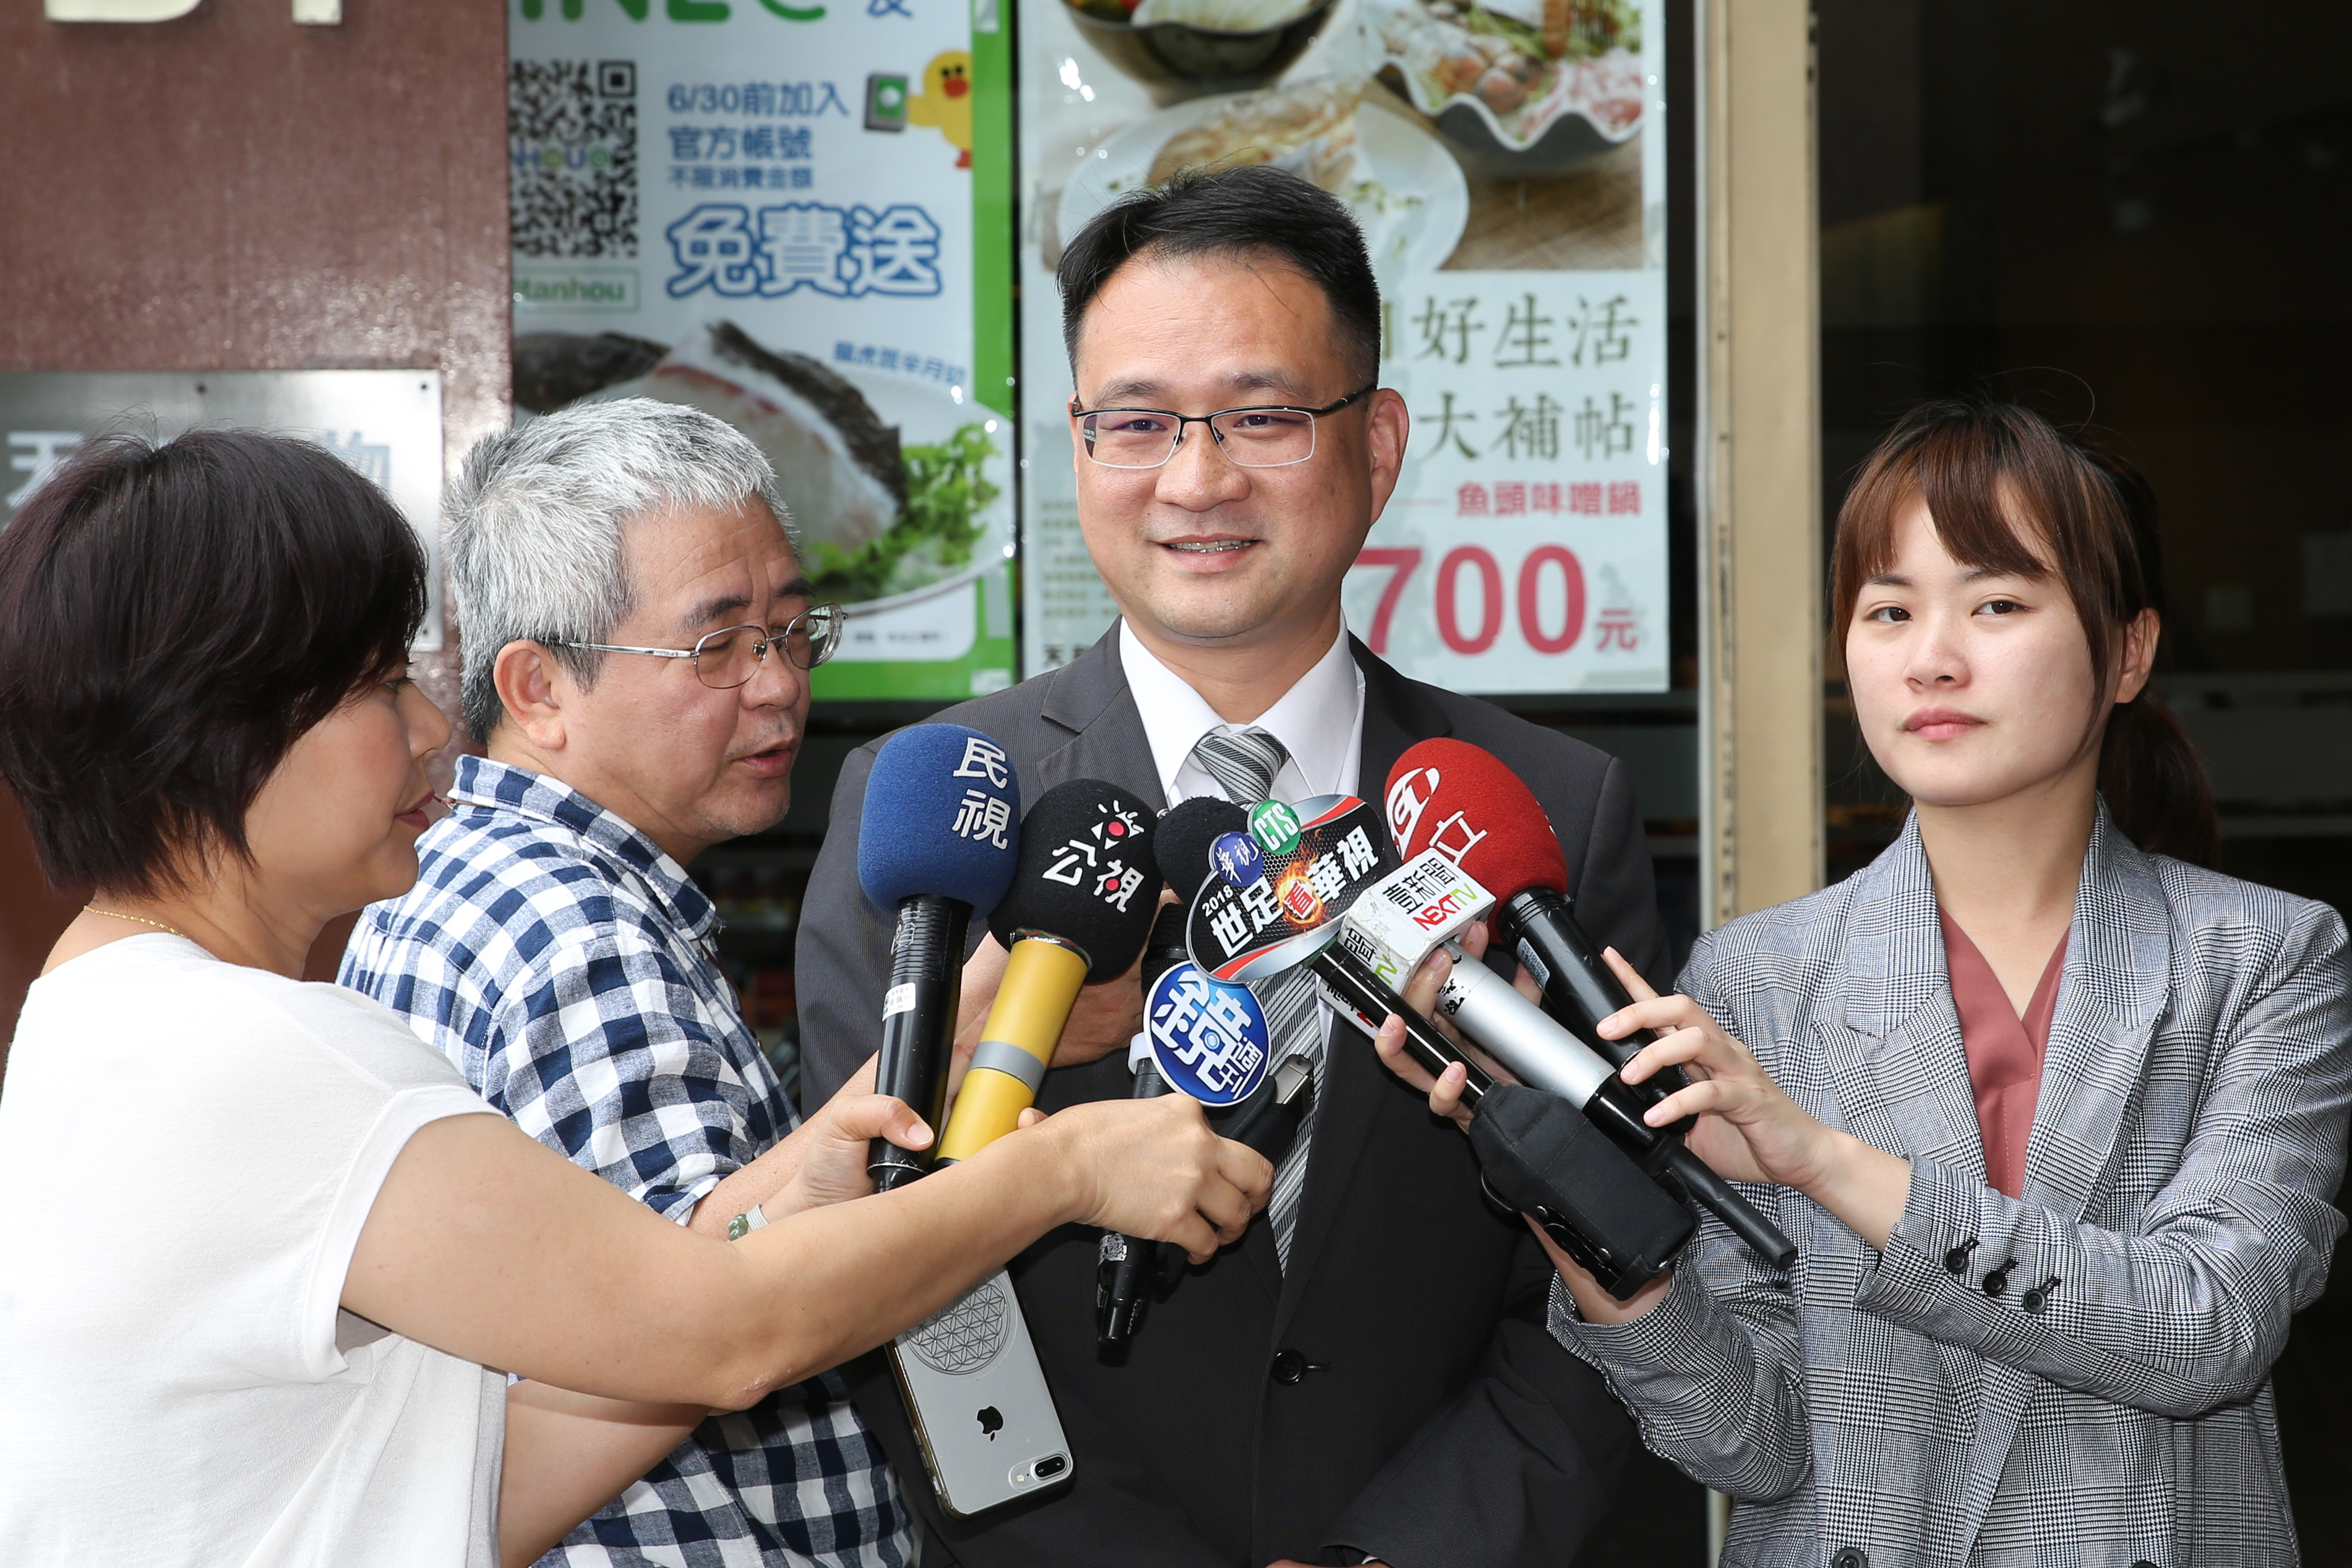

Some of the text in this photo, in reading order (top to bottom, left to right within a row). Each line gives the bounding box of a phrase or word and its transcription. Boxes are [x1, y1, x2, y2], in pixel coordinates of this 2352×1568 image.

[667, 82, 849, 116] 6/30前加入
[668, 125, 812, 159] 官方帳號
[666, 202, 941, 297] 免費送
[1381, 293, 1639, 367] 好生活
[1415, 392, 1637, 461] 大補帖
[953, 737, 1010, 849] 民視
[1254, 803, 1298, 851] CTS
[1042, 839, 1144, 912] 公視
[1215, 837, 1260, 883] 華視
[1382, 857, 1460, 914] 壹新聞
[1202, 885, 1234, 917] 2018
